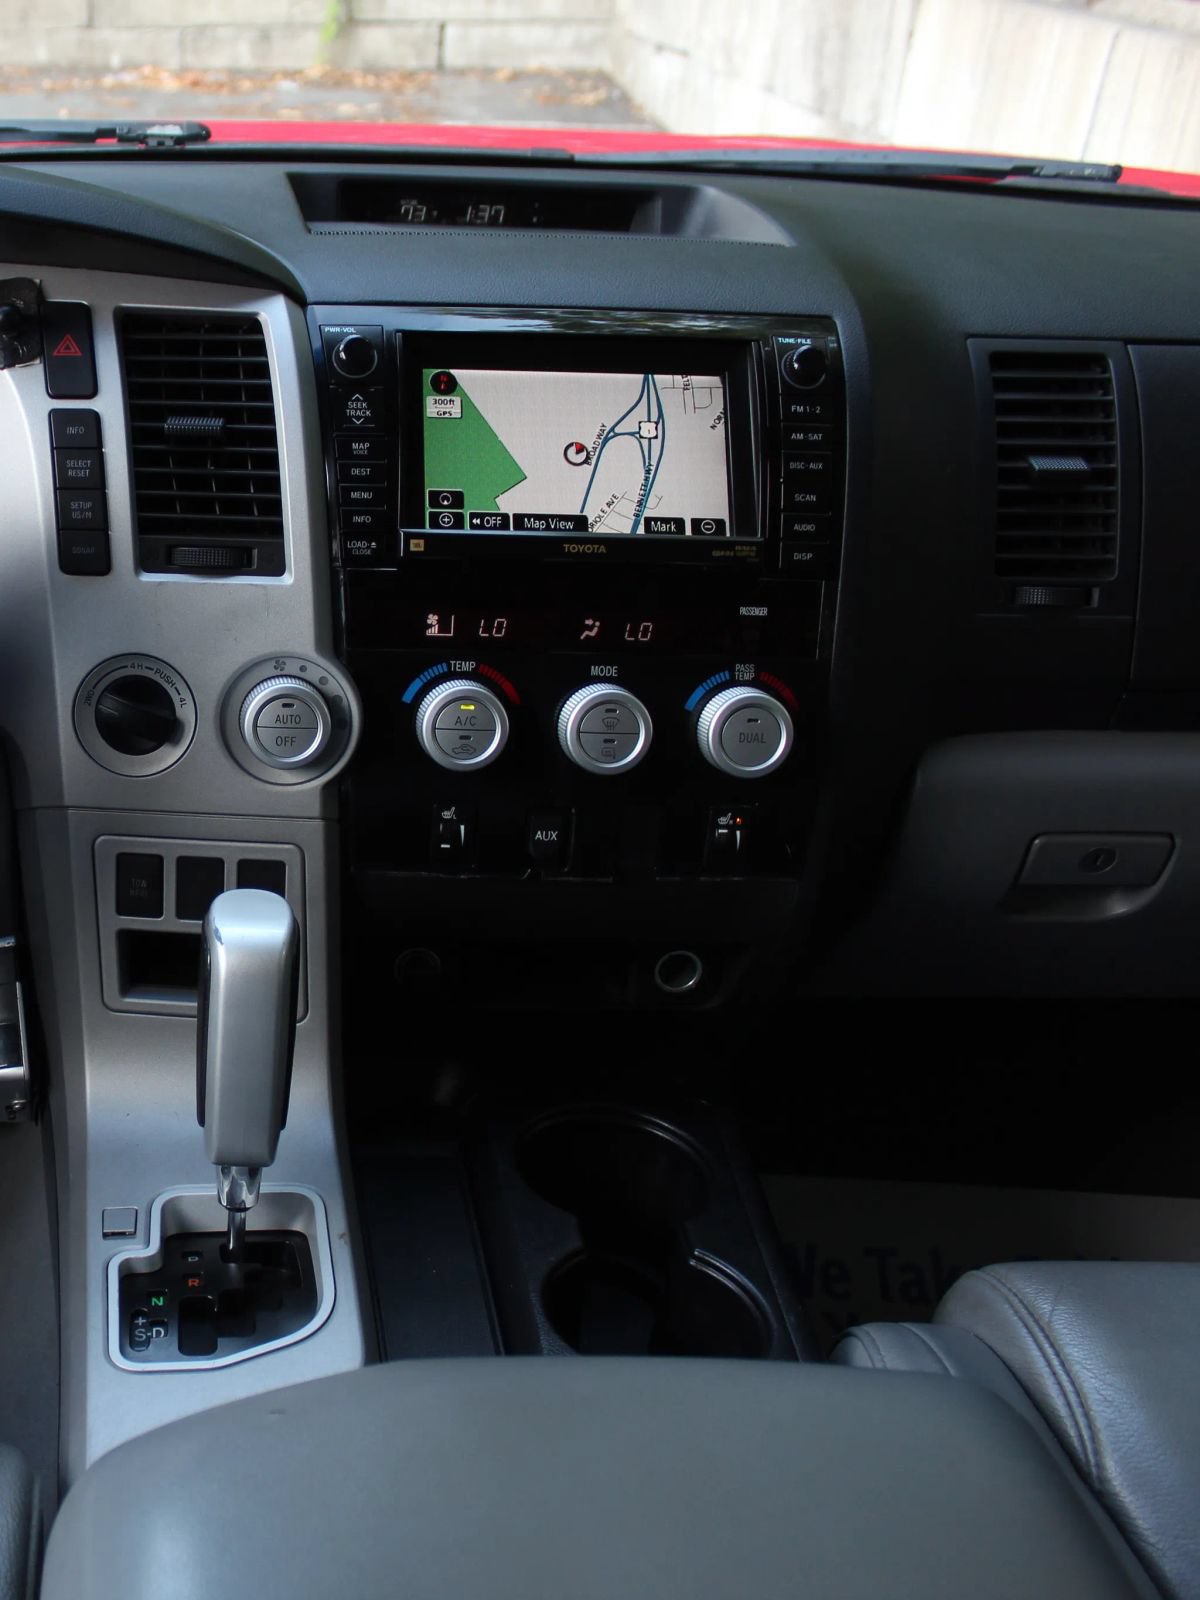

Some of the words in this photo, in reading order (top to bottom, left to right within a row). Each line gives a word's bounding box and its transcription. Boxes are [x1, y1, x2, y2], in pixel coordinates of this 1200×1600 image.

[401, 205, 427, 221] 73
[467, 205, 505, 222] 1:37
[348, 401, 368, 409] SEEK
[346, 409, 372, 417] TRACK
[66, 426, 85, 434] INFO
[66, 460, 91, 468] SELECT
[68, 469, 90, 477] RESET
[351, 468, 371, 476] DEST
[351, 491, 373, 499] MENU
[794, 493, 817, 501] SCAN
[605, 493, 619, 508] AVE
[484, 516, 502, 528] OFF
[524, 518, 545, 531] Map
[548, 518, 575, 530] View
[650, 521, 677, 532] Mark
[793, 523, 816, 531] AUDIO
[563, 543, 607, 553] TOYOTA
[793, 552, 813, 560] DISP
[739, 606, 768, 616] PASSENGER
[450, 660, 476, 672] TEMP
[590, 665, 618, 677] MODE
[735, 664, 755, 672] PASS
[153, 667, 176, 688] PUSH
[734, 672, 755, 681] TEMP
[275, 714, 301, 725] AUTO
[454, 716, 477, 726] A/C
[275, 735, 297, 747] OFF
[738, 732, 767, 744] DUAL
[535, 830, 558, 841] AUX
[188, 1279, 200, 1287] R
[151, 1296, 164, 1306] N
